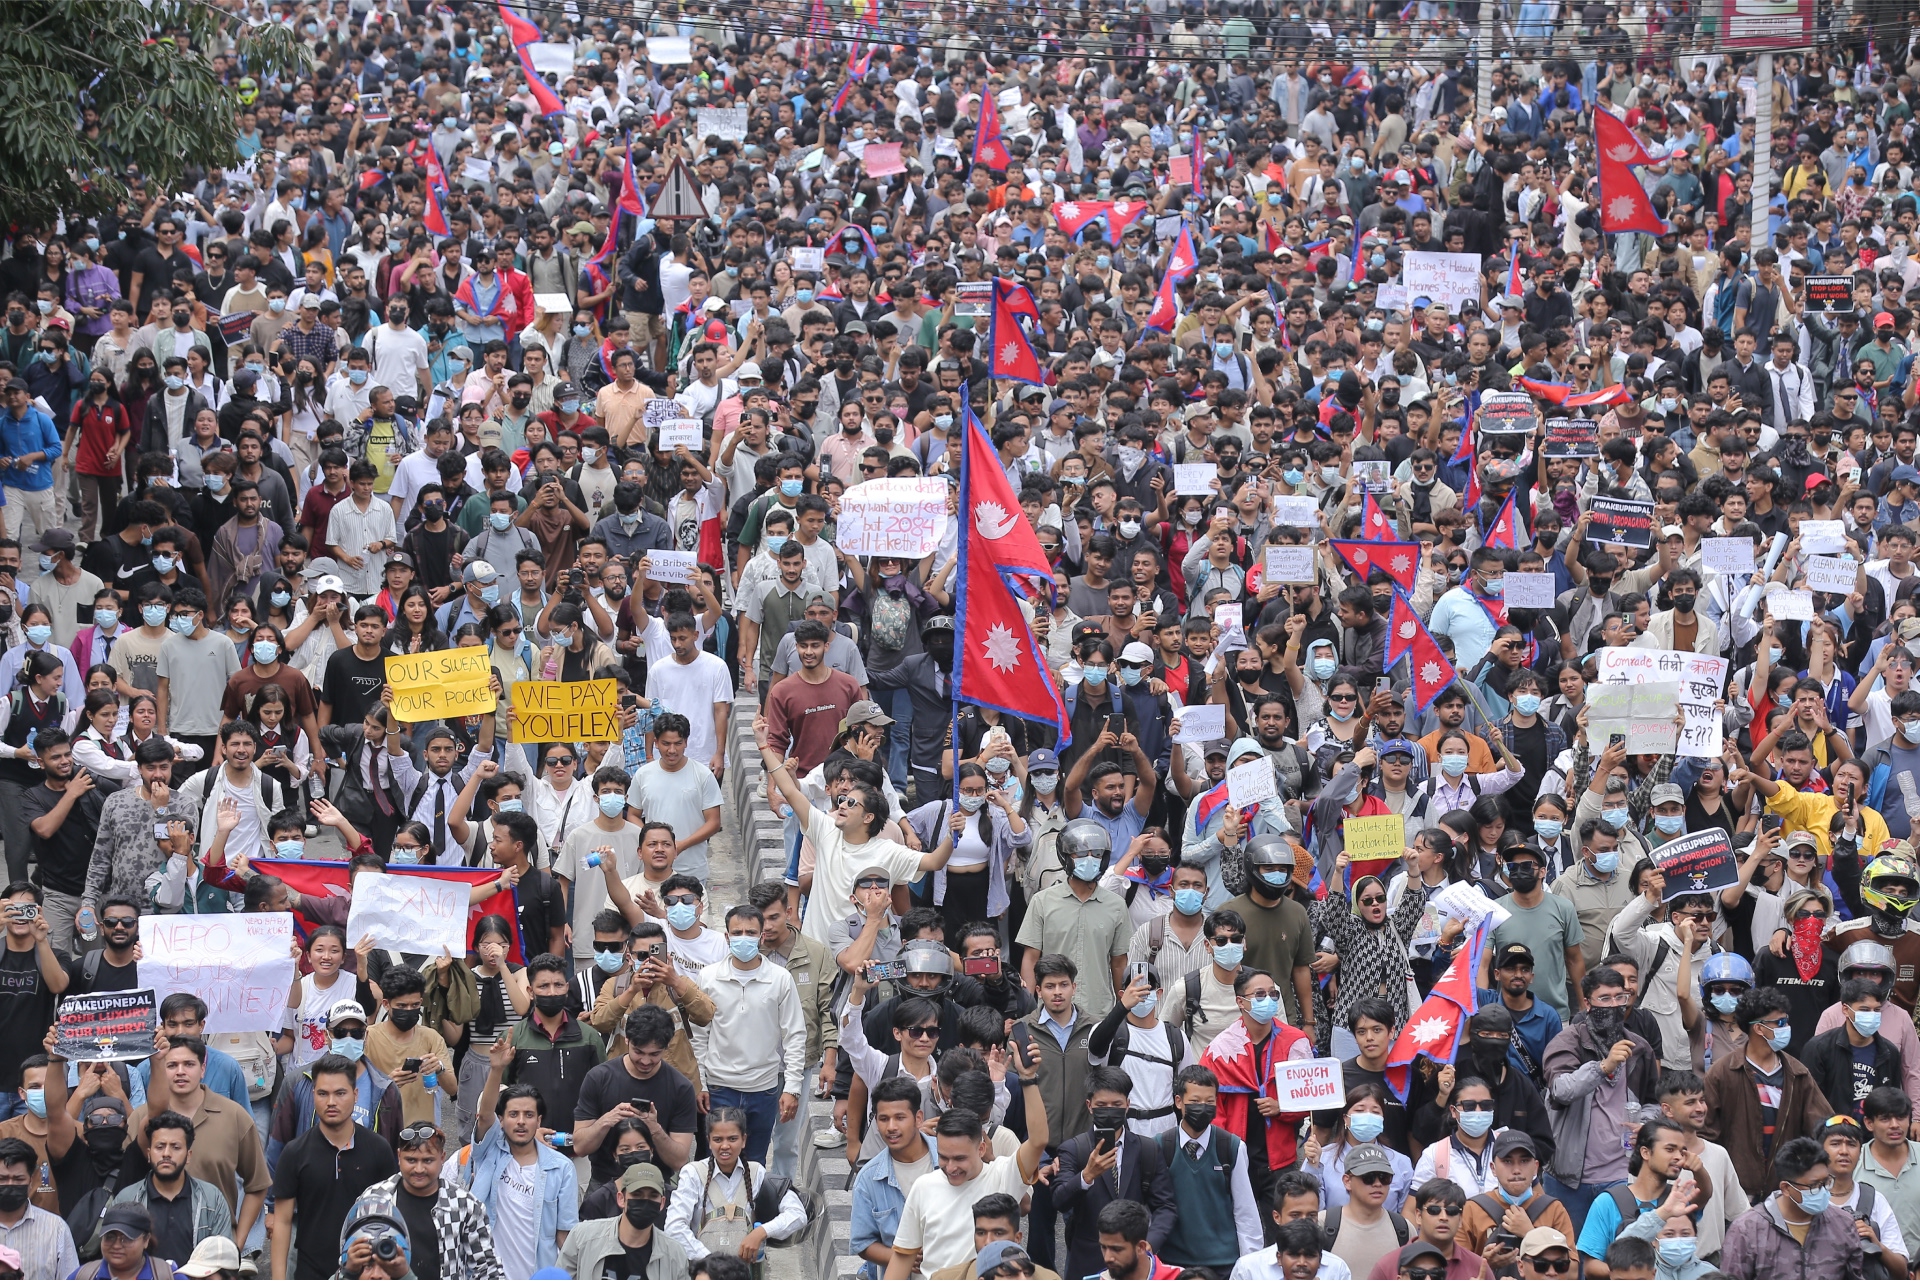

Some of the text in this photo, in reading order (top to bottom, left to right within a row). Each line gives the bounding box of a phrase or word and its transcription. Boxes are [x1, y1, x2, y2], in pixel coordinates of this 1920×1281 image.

[841, 497, 866, 518] They
[868, 498, 891, 513] want
[893, 502, 916, 514] our
[1594, 501, 1651, 514] #WAKEUPNEPAL
[862, 516, 935, 537] but 2084
[663, 559, 692, 567] Bribes
[1724, 555, 1738, 563] THE
[1813, 557, 1836, 570] CLEAN
[1809, 571, 1831, 584] CLEAN
[1519, 585, 1534, 593] THE
[388, 653, 490, 683] OUR SWEAT,
[1606, 650, 1653, 669] Comrade
[392, 692, 436, 714] YOUR
[519, 685, 563, 710] WE
[1655, 832, 1726, 861] #WAKEUPNEPAL
[1658, 857, 1679, 870] STOP
[1669, 864, 1693, 877] START
[1443, 896, 1466, 918] Citizens
[244, 916, 288, 926] NEPO BABY
[151, 922, 232, 955] NEPO
[167, 956, 258, 988] BABY
[58, 994, 152, 1014] #WAKEUPNEPAL
[60, 1007, 150, 1025] YOUR LUXURY
[64, 1021, 147, 1038] OUR MISERY!
[1286, 1067, 1329, 1080] ENOUGH
[1290, 1082, 1335, 1099] ENOUGH
[1303, 1078, 1314, 1087] IS
[1359, 1148, 1382, 1160] PARIS
